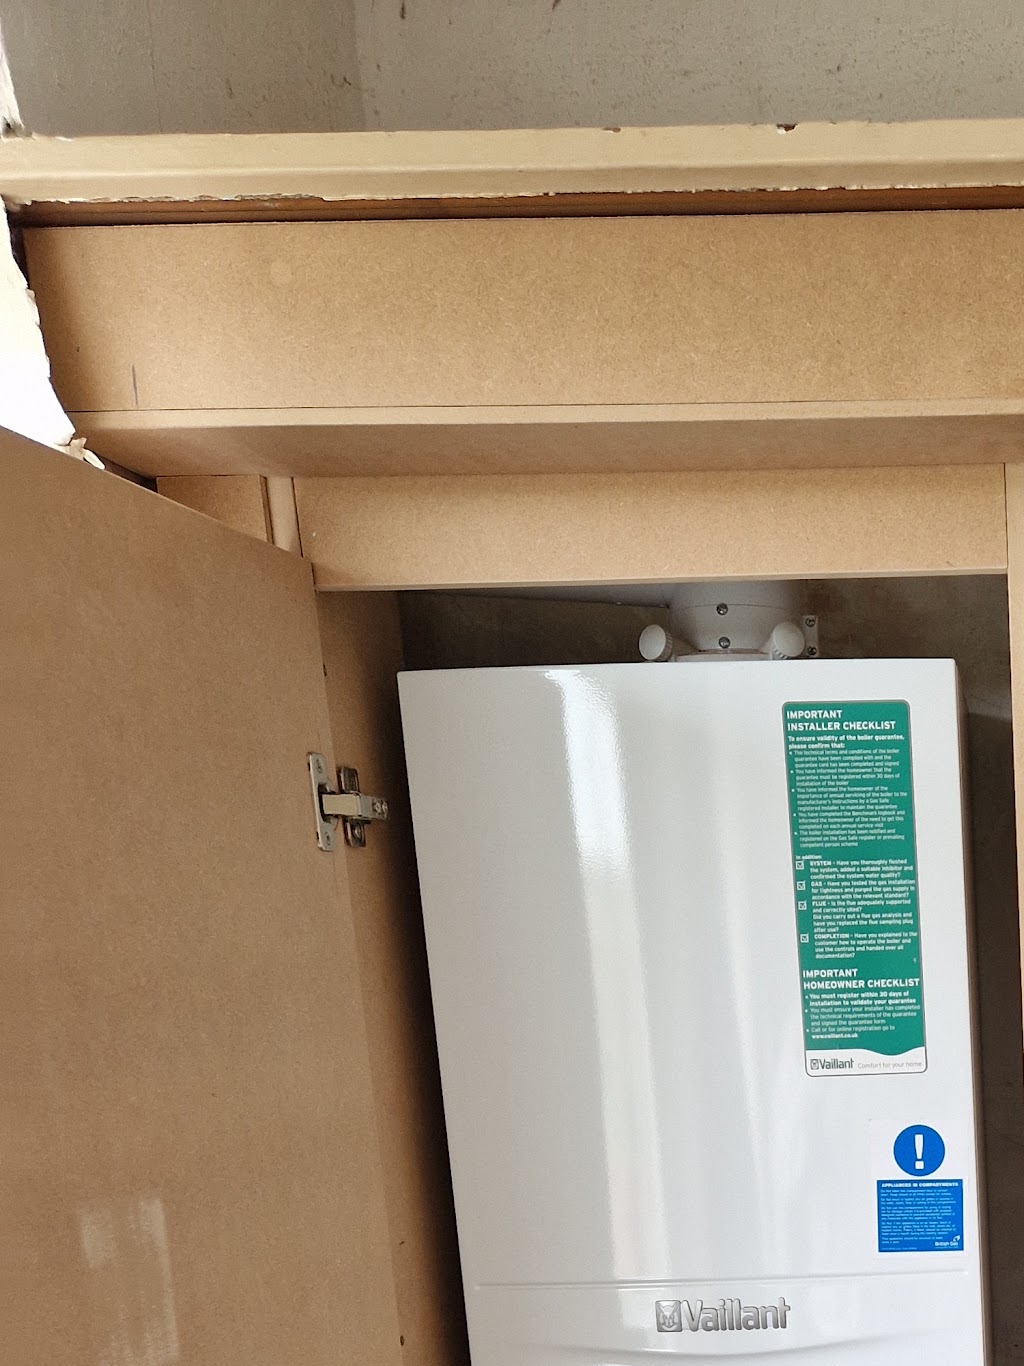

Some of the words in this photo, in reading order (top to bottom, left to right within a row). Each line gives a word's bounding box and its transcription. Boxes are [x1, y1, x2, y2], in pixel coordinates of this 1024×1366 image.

[787, 710, 842, 719] IMPORTANT
[788, 722, 840, 731] INSTALLER
[843, 721, 896, 730] CHECKLIST
[803, 969, 858, 978] IMPORTANT
[804, 980, 865, 990] HOMEOWNER
[867, 978, 919, 987] CHECKLIST
[819, 1058, 854, 1069] Vaillant
[682, 1297, 791, 1332] Vaillant
